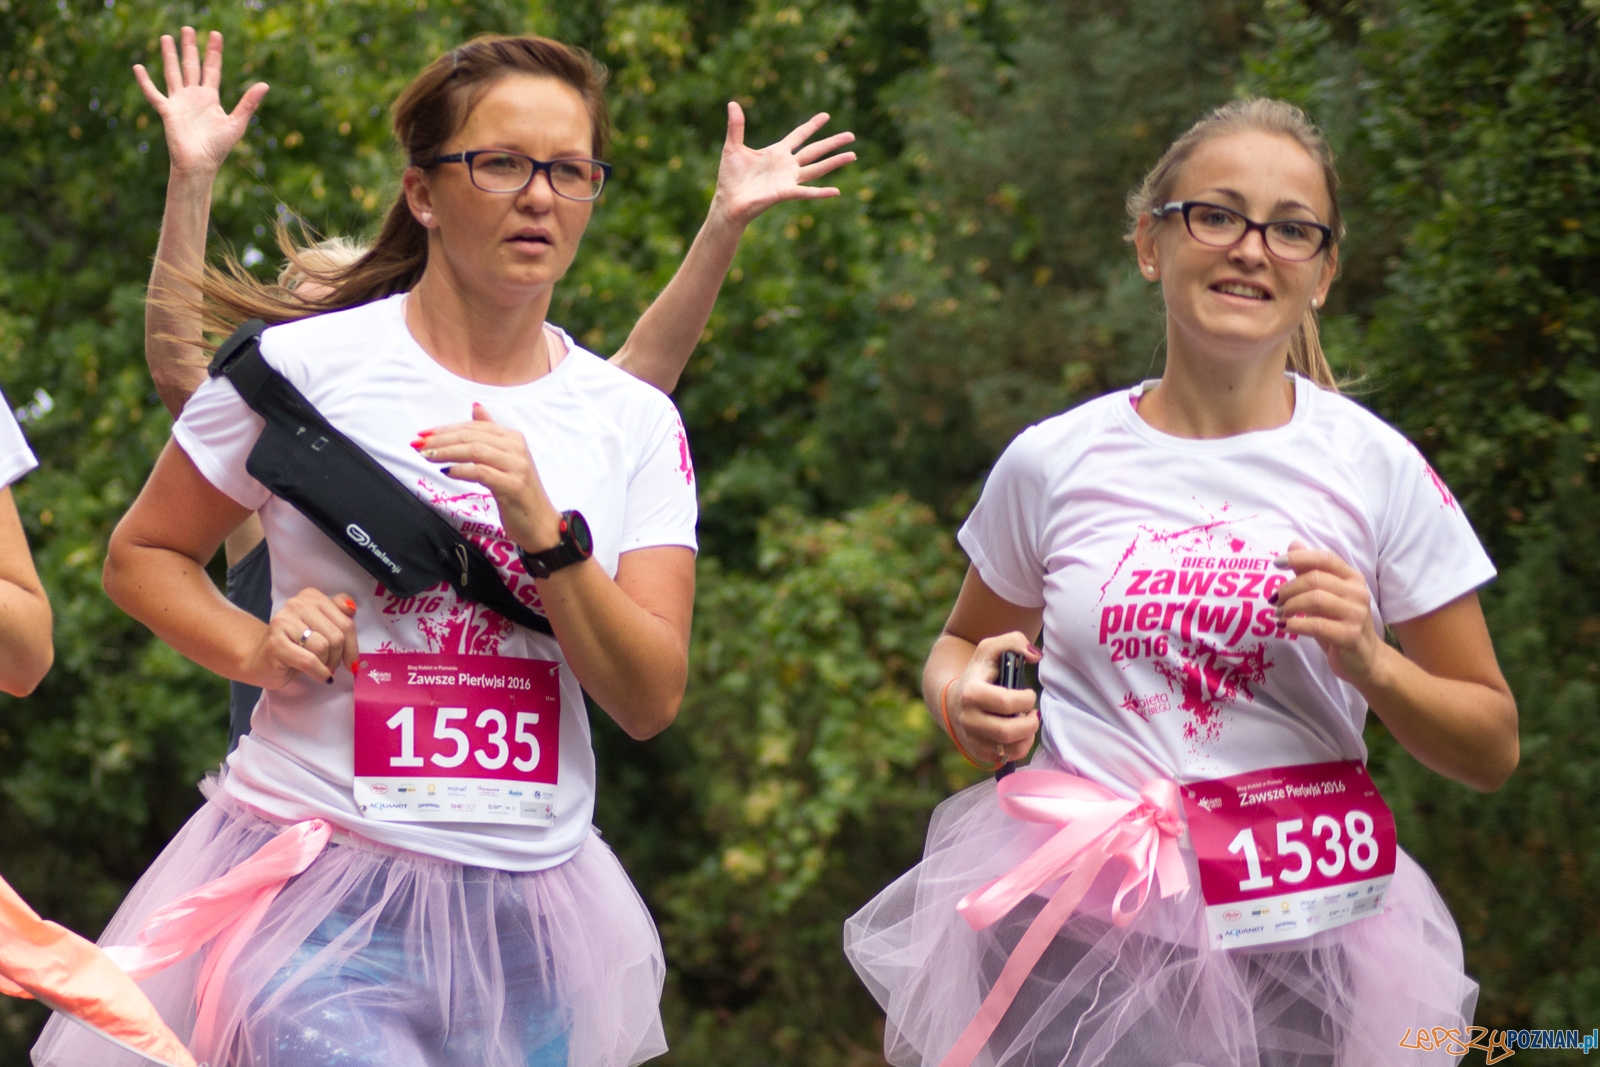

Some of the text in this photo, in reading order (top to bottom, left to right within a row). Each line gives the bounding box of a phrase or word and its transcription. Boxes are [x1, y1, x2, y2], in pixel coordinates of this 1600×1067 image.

[460, 521, 495, 536] BIEG
[367, 541, 402, 574] Kalenji
[1181, 556, 1272, 571] BIEG KOBIET
[1125, 568, 1288, 600] zawsze
[382, 594, 444, 615] 2016
[1110, 634, 1169, 663] 2016
[407, 672, 531, 690] Zawsze Pier(w)si 2016
[1147, 702, 1171, 716] BIEGU
[386, 706, 541, 772] 1535
[1239, 788, 1285, 807] Zawsze
[1285, 783, 1321, 799] Pier(w)si
[1321, 780, 1346, 795] 2016
[1227, 809, 1379, 893] 1538
